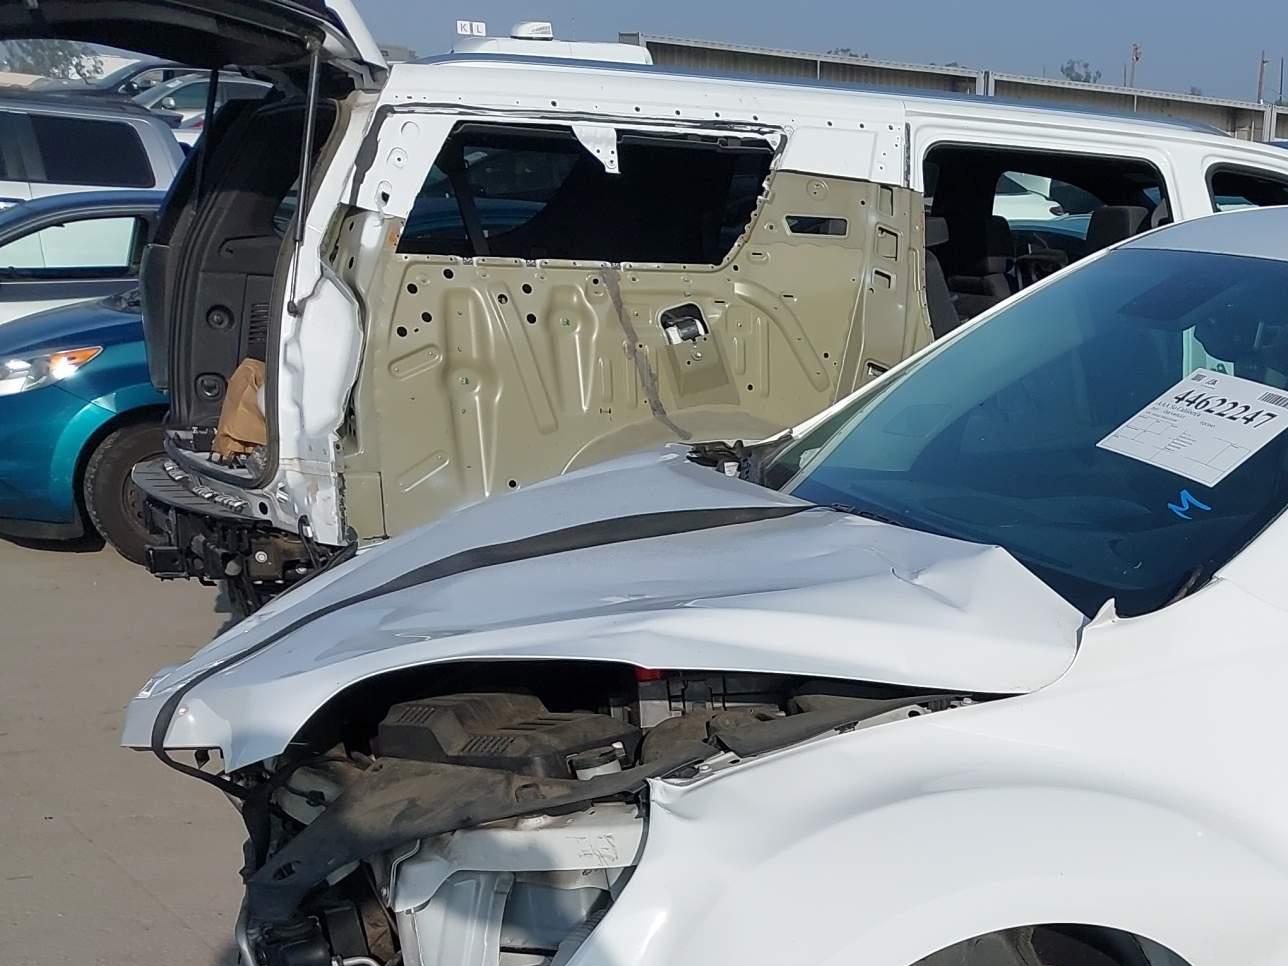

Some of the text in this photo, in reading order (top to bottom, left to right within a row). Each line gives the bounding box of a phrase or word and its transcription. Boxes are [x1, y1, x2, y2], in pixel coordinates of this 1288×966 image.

[459, 23, 468, 32] K
[475, 23, 483, 33] L
[1173, 389, 1280, 429] 44622247
[1167, 489, 1213, 520] M
